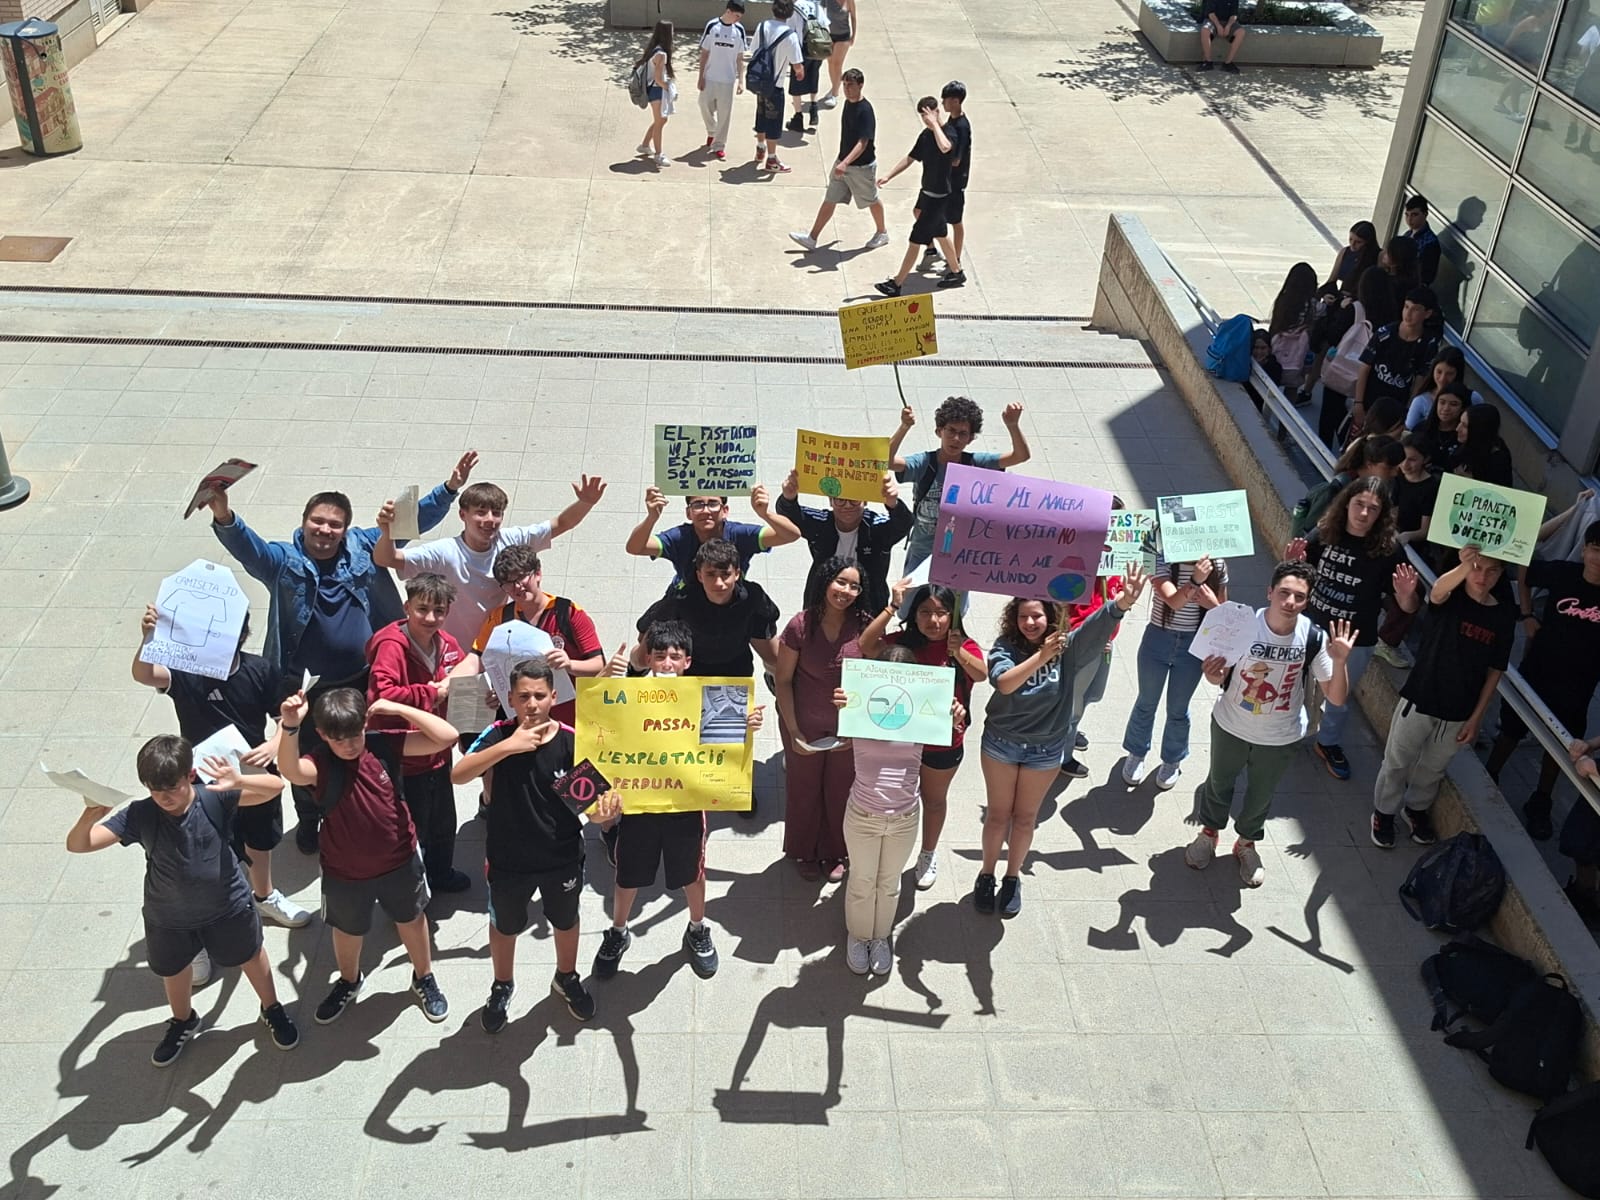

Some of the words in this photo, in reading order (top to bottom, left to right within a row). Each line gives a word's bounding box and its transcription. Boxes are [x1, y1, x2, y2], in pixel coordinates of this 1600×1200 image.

[664, 425, 690, 441] EL
[701, 426, 730, 440] FAST
[801, 434, 817, 446] LA
[823, 439, 860, 452] MODA
[803, 464, 818, 476] EL
[825, 467, 878, 483] PLANETA
[697, 478, 747, 490] PLANETA
[970, 480, 999, 506] QUE
[1006, 486, 1033, 508] MI
[1038, 493, 1085, 511] MANERA
[1453, 492, 1466, 506] EL
[1471, 496, 1517, 518] PLANETA
[1110, 513, 1143, 527] FAST
[1459, 511, 1473, 522] NO
[967, 516, 997, 539] DE
[1006, 523, 1057, 541] VESTIR
[1057, 528, 1077, 545] NO
[953, 548, 1003, 567] AFECTE
[1009, 553, 1021, 567] A
[1032, 554, 1054, 568] MI
[1329, 550, 1357, 567] EAT
[175, 575, 220, 593] CAMISETA
[985, 570, 1038, 585] MUNDO
[1322, 567, 1363, 587] SLEEP
[1311, 595, 1357, 620] REPEAT
[845, 660, 861, 672] EL
[890, 674, 907, 685] NO
[1274, 663, 1303, 711] LUFFY
[603, 690, 627, 704] LA
[637, 689, 678, 704] MODA
[643, 717, 696, 732] PASSA,
[612, 777, 684, 790] PERDURA
